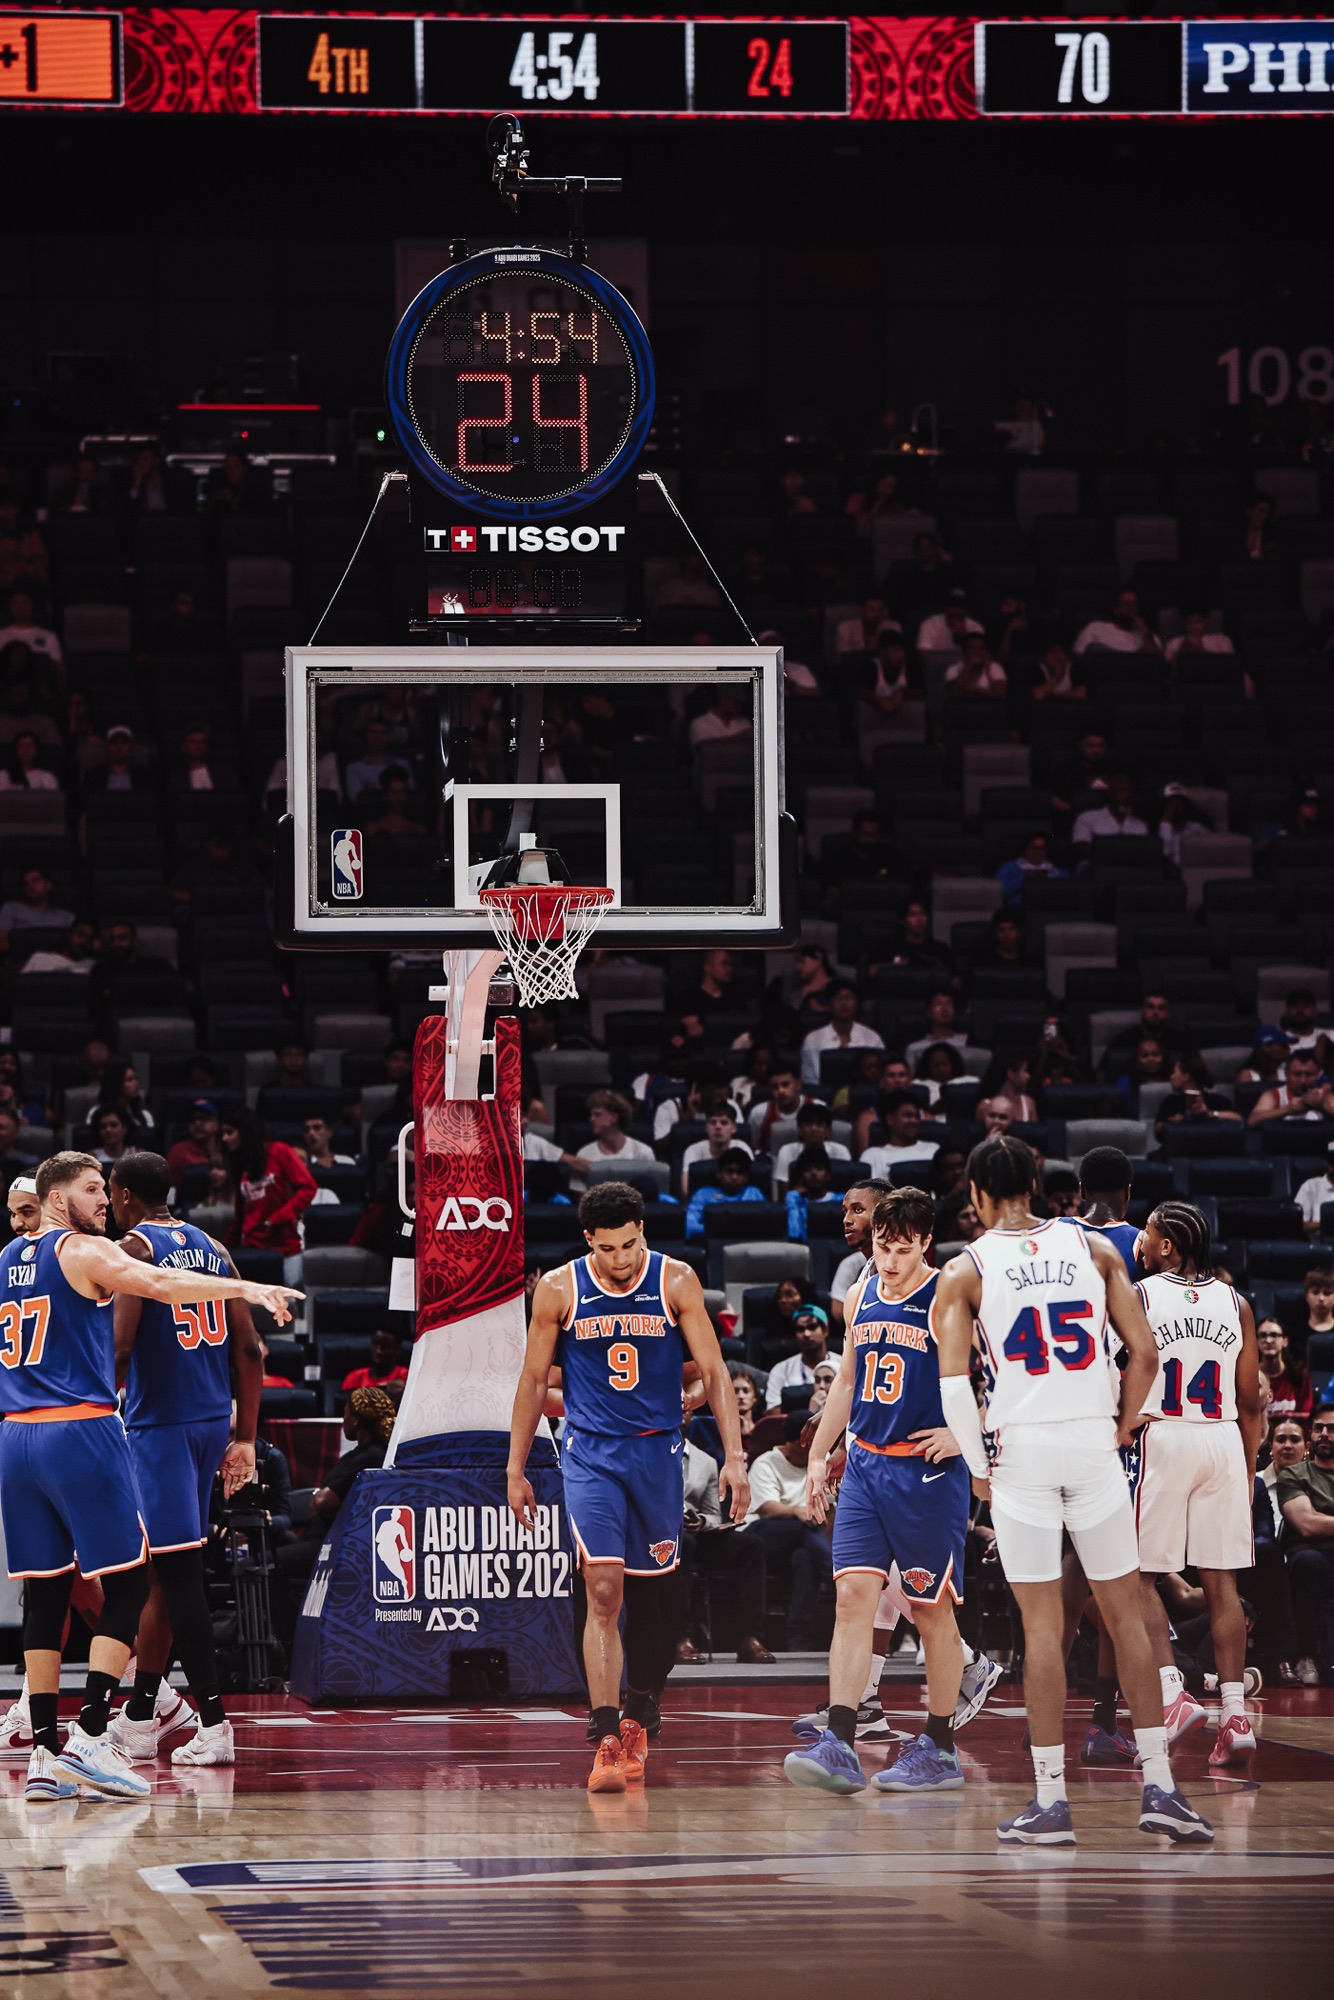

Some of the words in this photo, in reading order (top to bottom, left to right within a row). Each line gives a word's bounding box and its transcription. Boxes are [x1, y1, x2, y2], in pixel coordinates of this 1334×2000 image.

[308, 32, 369, 94] 4TH
[508, 31, 601, 101] 4:54
[747, 38, 793, 98] 24
[1054, 32, 1110, 103] 70
[1203, 42, 1334, 93] PHI
[482, 312, 598, 364] 4:54
[1217, 345, 1334, 406] 108
[457, 373, 588, 473] 24
[481, 526, 626, 552] TISSOT
[337, 883, 352, 894] NBA
[435, 1196, 513, 1232] ADQ
[8, 1263, 37, 1288] RYAN
[1005, 1260, 1077, 1291] SALLIS
[0, 1295, 51, 1370] 37
[171, 1299, 228, 1350] 50
[574, 1315, 616, 1340] NEW
[616, 1313, 666, 1337] YORK
[852, 1321, 885, 1348] NEW
[885, 1321, 929, 1353] YORK
[1003, 1300, 1096, 1376] 45
[607, 1342, 640, 1391] 9
[861, 1350, 906, 1405] 13
[1161, 1357, 1223, 1419] 14
[423, 1506, 475, 1552] ABU
[481, 1505, 560, 1551] DHABI
[380, 1581, 400, 1596] NBA
[424, 1552, 511, 1600] GAMES
[516, 1551, 573, 1598] 202
[375, 1608, 412, 1622] Presented
[413, 1607, 422, 1623] by
[425, 1607, 479, 1632] ADQ
